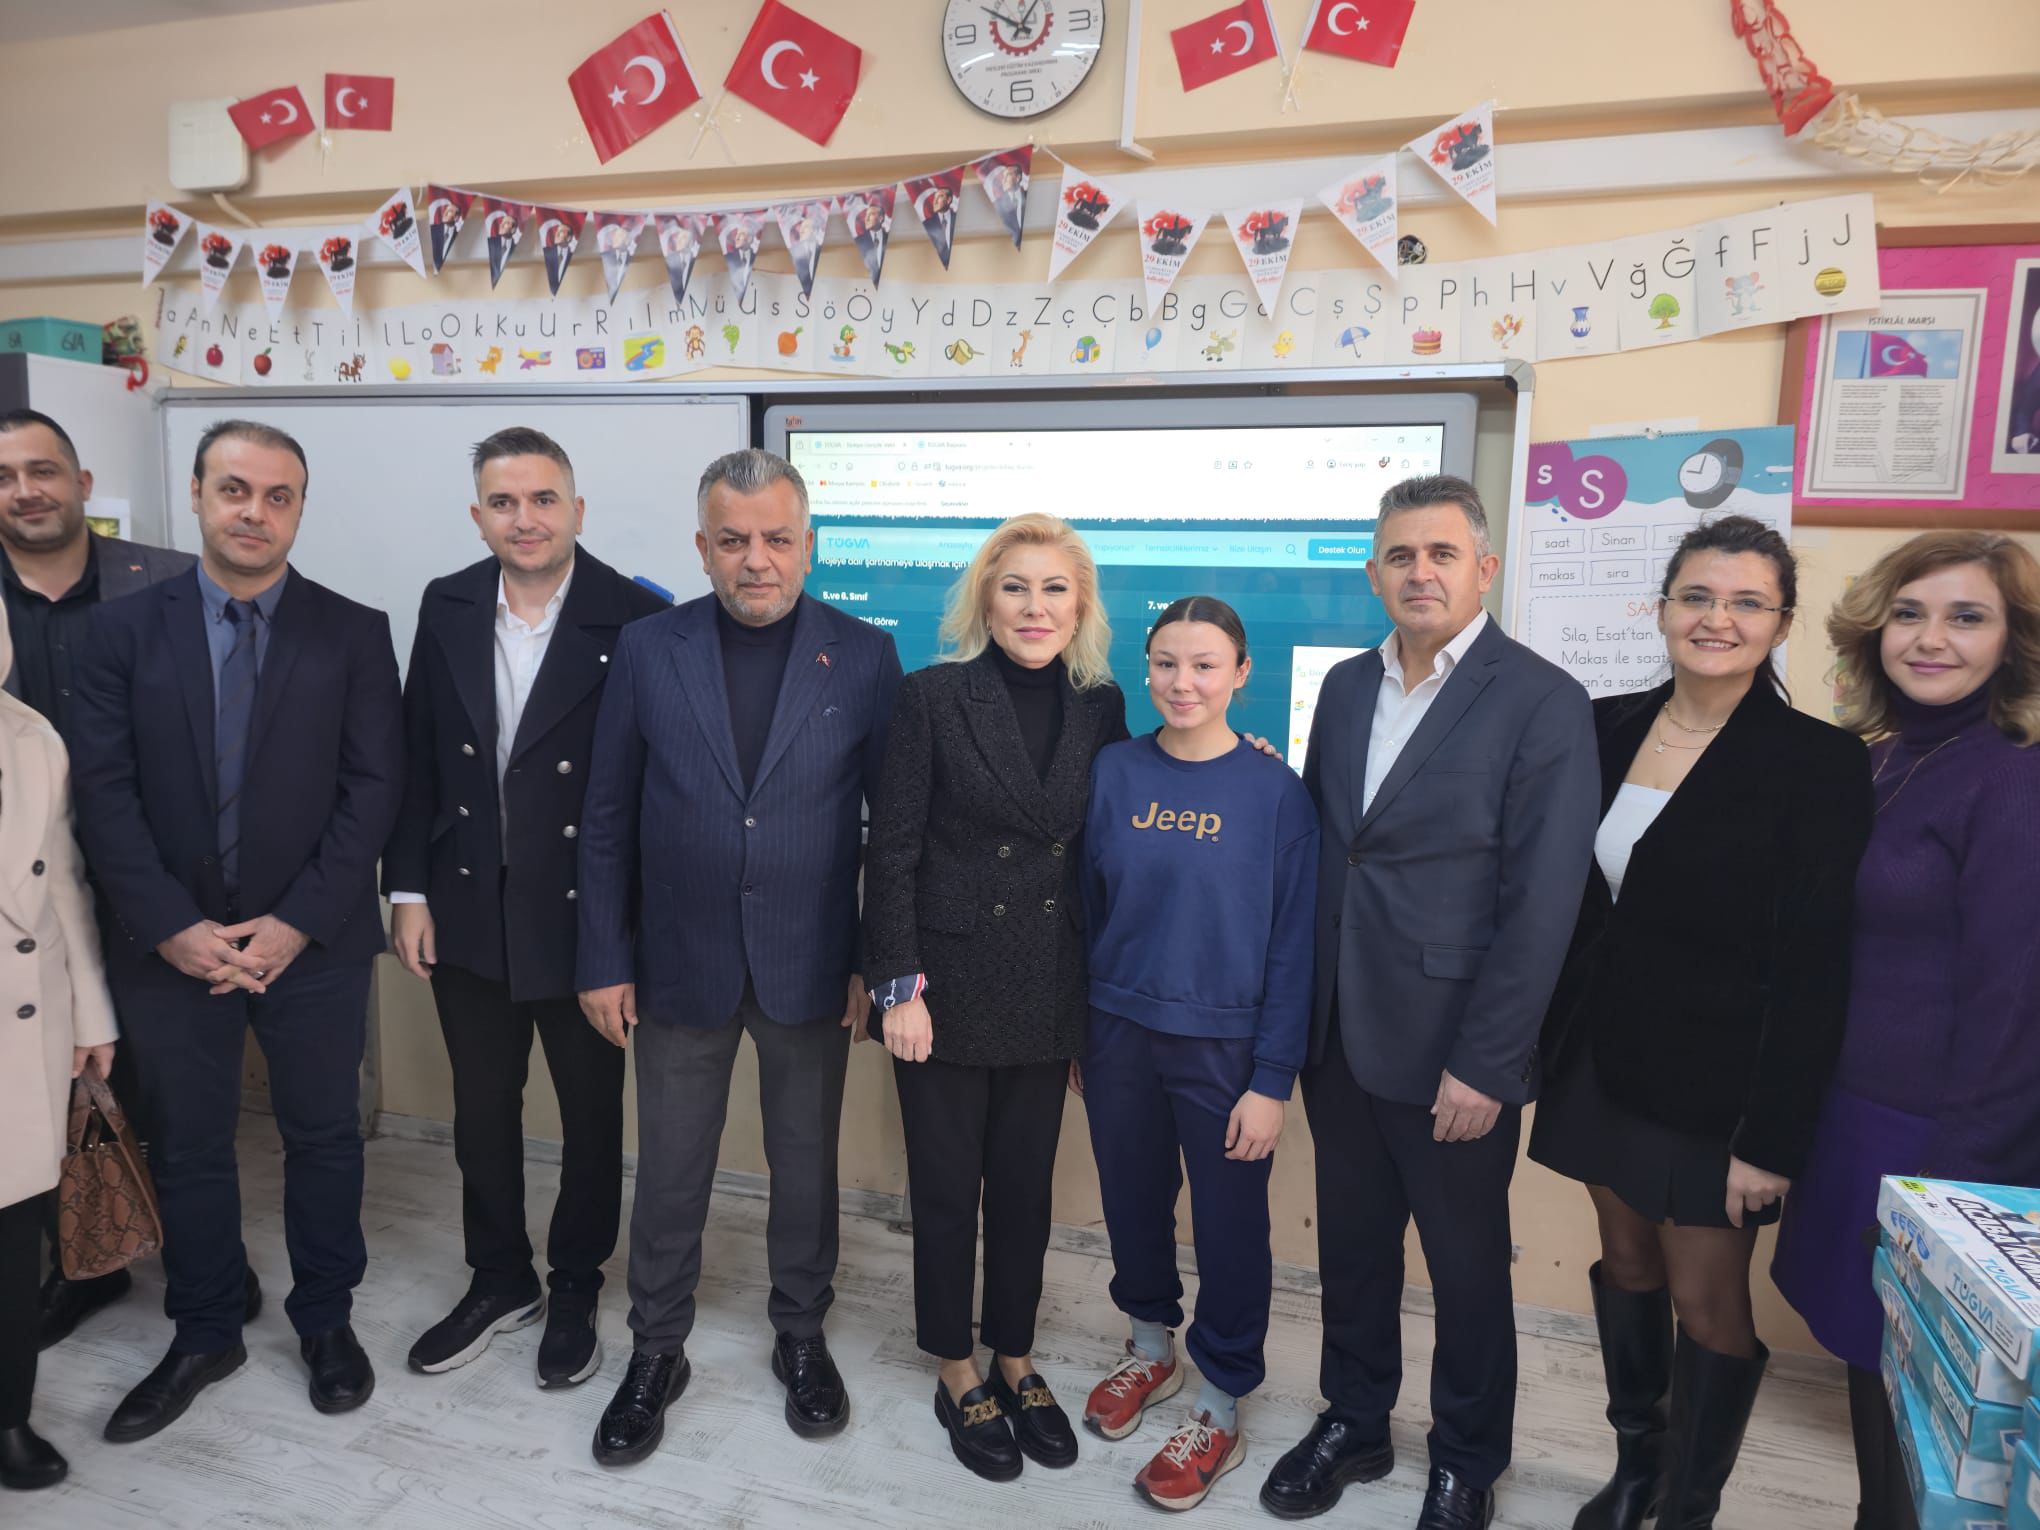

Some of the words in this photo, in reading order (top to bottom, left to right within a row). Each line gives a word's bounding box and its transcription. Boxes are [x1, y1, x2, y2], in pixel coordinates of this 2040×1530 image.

[1069, 9, 1091, 32] 3
[955, 24, 976, 46] 9
[1010, 80, 1034, 103] 6
[221, 313, 238, 339] N
[312, 322, 323, 346] T
[401, 321, 415, 345] L
[441, 313, 460, 337] O
[475, 313, 483, 337] k
[496, 314, 508, 337] K
[573, 323, 582, 337] r
[596, 309, 608, 335] R
[715, 296, 725, 314] ü
[771, 301, 780, 316] s
[824, 301, 836, 320] ö
[847, 287, 873, 321] Ö
[881, 308, 894, 334] y
[912, 297, 929, 325] Y
[942, 299, 955, 327] d
[972, 299, 992, 327] D
[1006, 311, 1017, 326] z
[1034, 297, 1051, 325] Z
[1062, 309, 1074, 328] ç
[1093, 295, 1116, 328] Ç
[1130, 294, 1143, 321] b
[1163, 292, 1178, 321] B
[1190, 303, 1206, 331] g
[1220, 289, 1248, 318] G
[1290, 287, 1316, 316] C
[1364, 284, 1382, 319] Ş
[1403, 296, 1418, 325] p
[1440, 280, 1457, 310] P
[1474, 277, 1488, 307] h
[1512, 269, 1535, 302] H
[1551, 279, 1567, 295] v
[1588, 259, 1614, 291] V
[1629, 263, 1647, 299] ğ
[1661, 237, 1696, 279] Ğ
[1715, 235, 1729, 268] f
[1752, 227, 1772, 261] F
[1798, 228, 1810, 266] j
[1832, 213, 1851, 247] J
[1537, 464, 1553, 485] s
[1579, 469, 1605, 508] S
[1545, 537, 1570, 549] saat
[1602, 532, 1636, 546] Sinan
[1319, 546, 1345, 554] Destek
[1347, 546, 1366, 555] Olun
[1539, 568, 1575, 581] makas
[873, 617, 898, 627] Görev
[1561, 650, 1608, 665] Makas
[1615, 648, 1630, 664] ile
[1132, 802, 1222, 840] Jeep
[1953, 1272, 1994, 1332] TÜGVA
